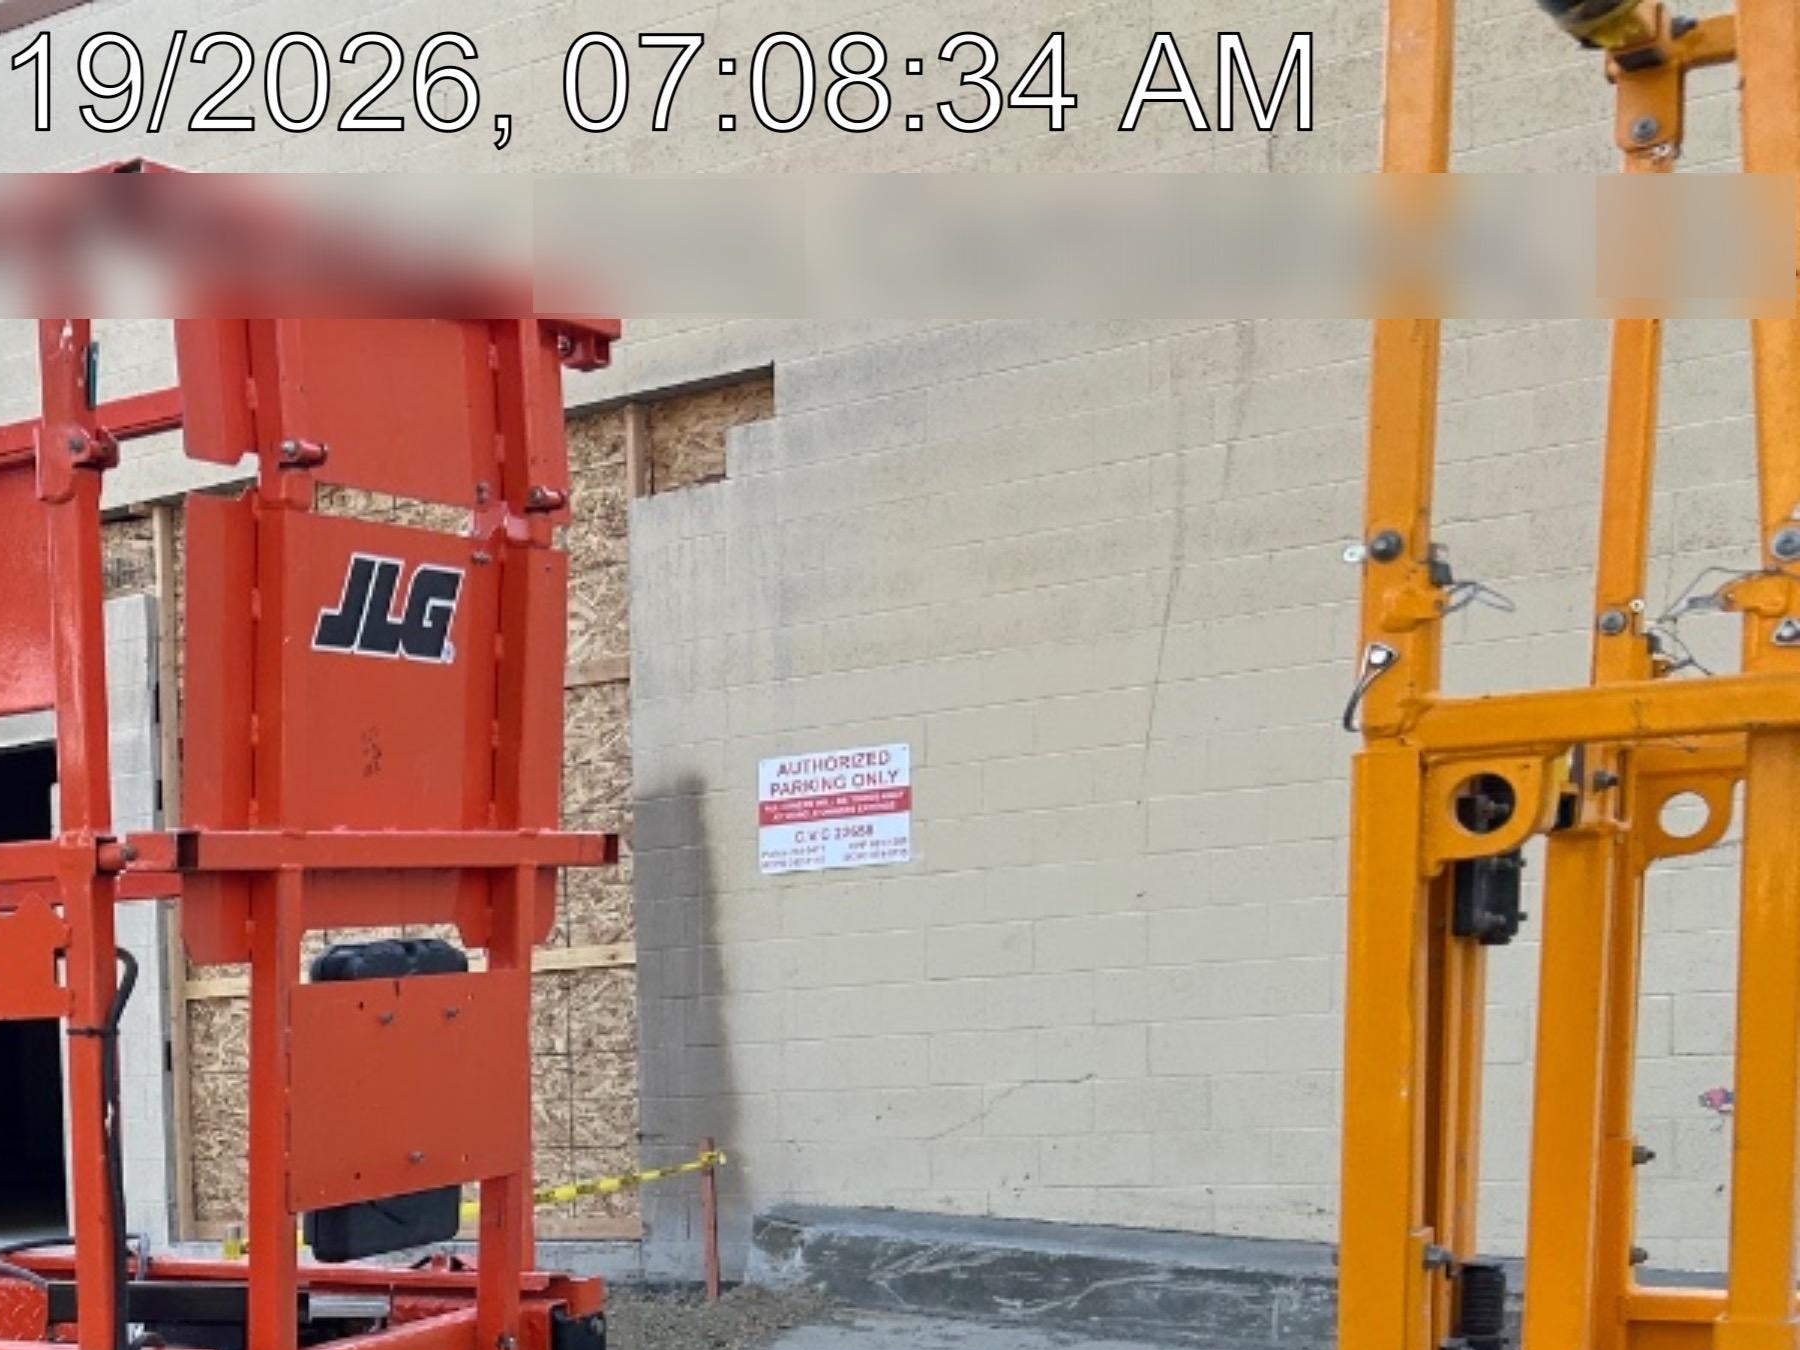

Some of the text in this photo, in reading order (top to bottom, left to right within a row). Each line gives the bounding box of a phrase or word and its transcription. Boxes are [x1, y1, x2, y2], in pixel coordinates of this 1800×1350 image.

[312, 552, 466, 664] JLG
[777, 750, 890, 775] AUTHORIZED
[770, 769, 899, 796] PARKING ONLY
